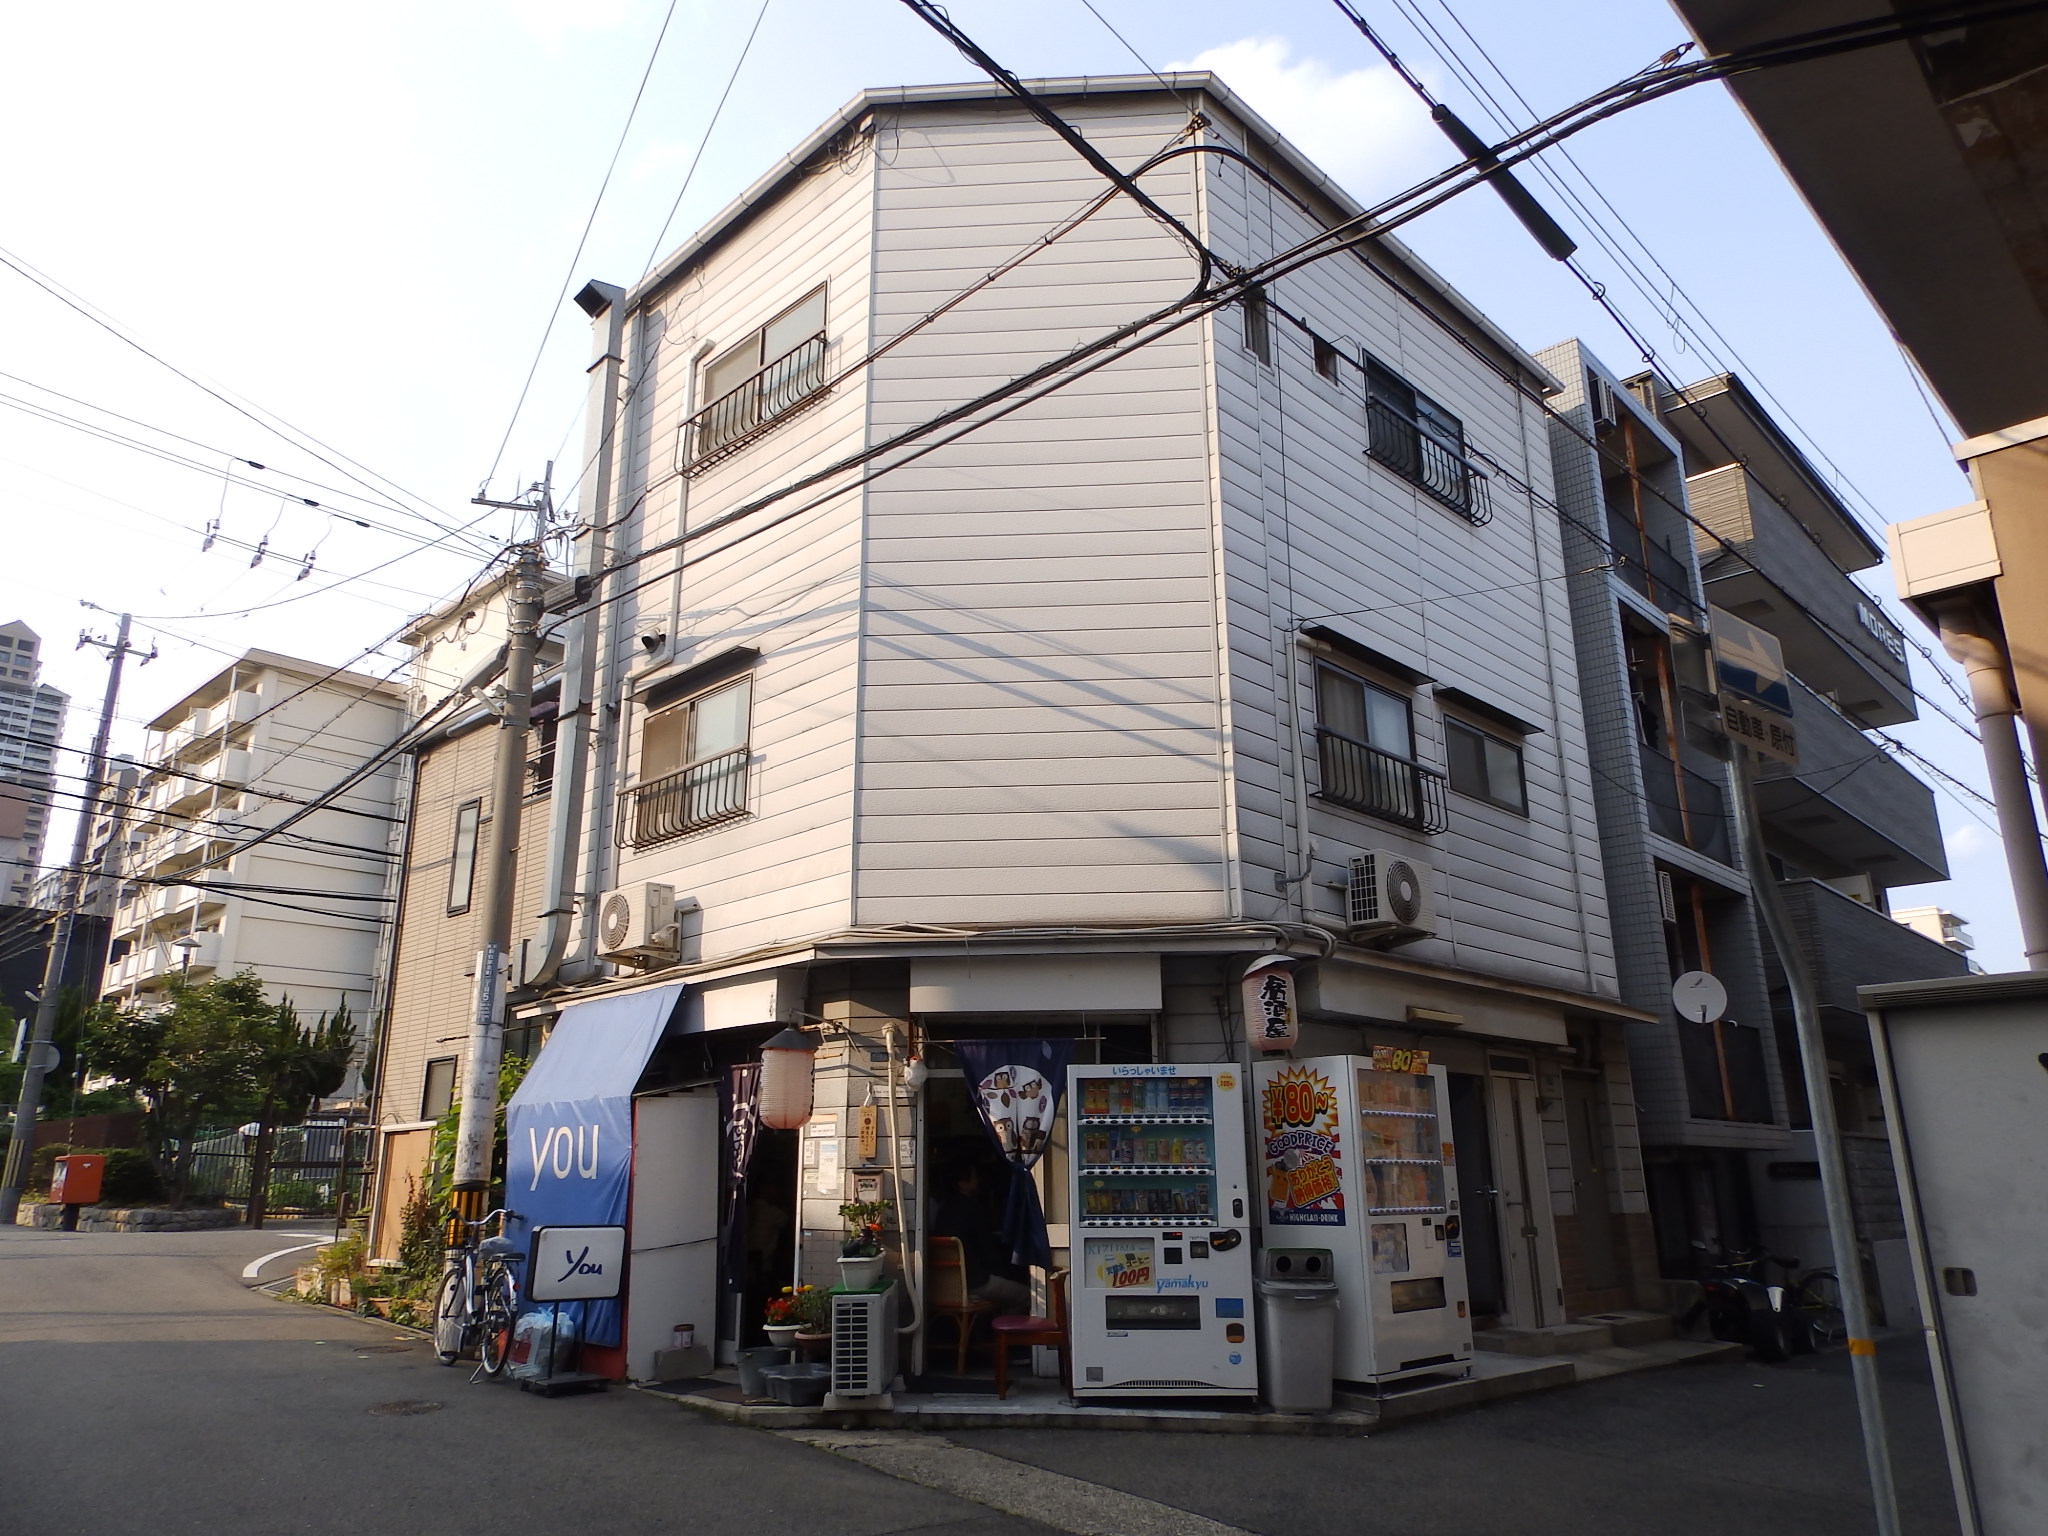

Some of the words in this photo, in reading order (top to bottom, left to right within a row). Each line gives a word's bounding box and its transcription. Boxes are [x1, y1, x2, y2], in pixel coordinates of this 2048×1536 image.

[1856, 602, 1905, 663] MORES
[1260, 975, 1290, 1038] 居酒屋
[1112, 1066, 1177, 1076] いらっしゃいませ
[529, 1124, 600, 1192] you
[1289, 1155, 1333, 1187] ありがとう
[557, 1246, 602, 1283] You
[1112, 1267, 1150, 1287] 100円
[1156, 1275, 1209, 1294] yamakyu
